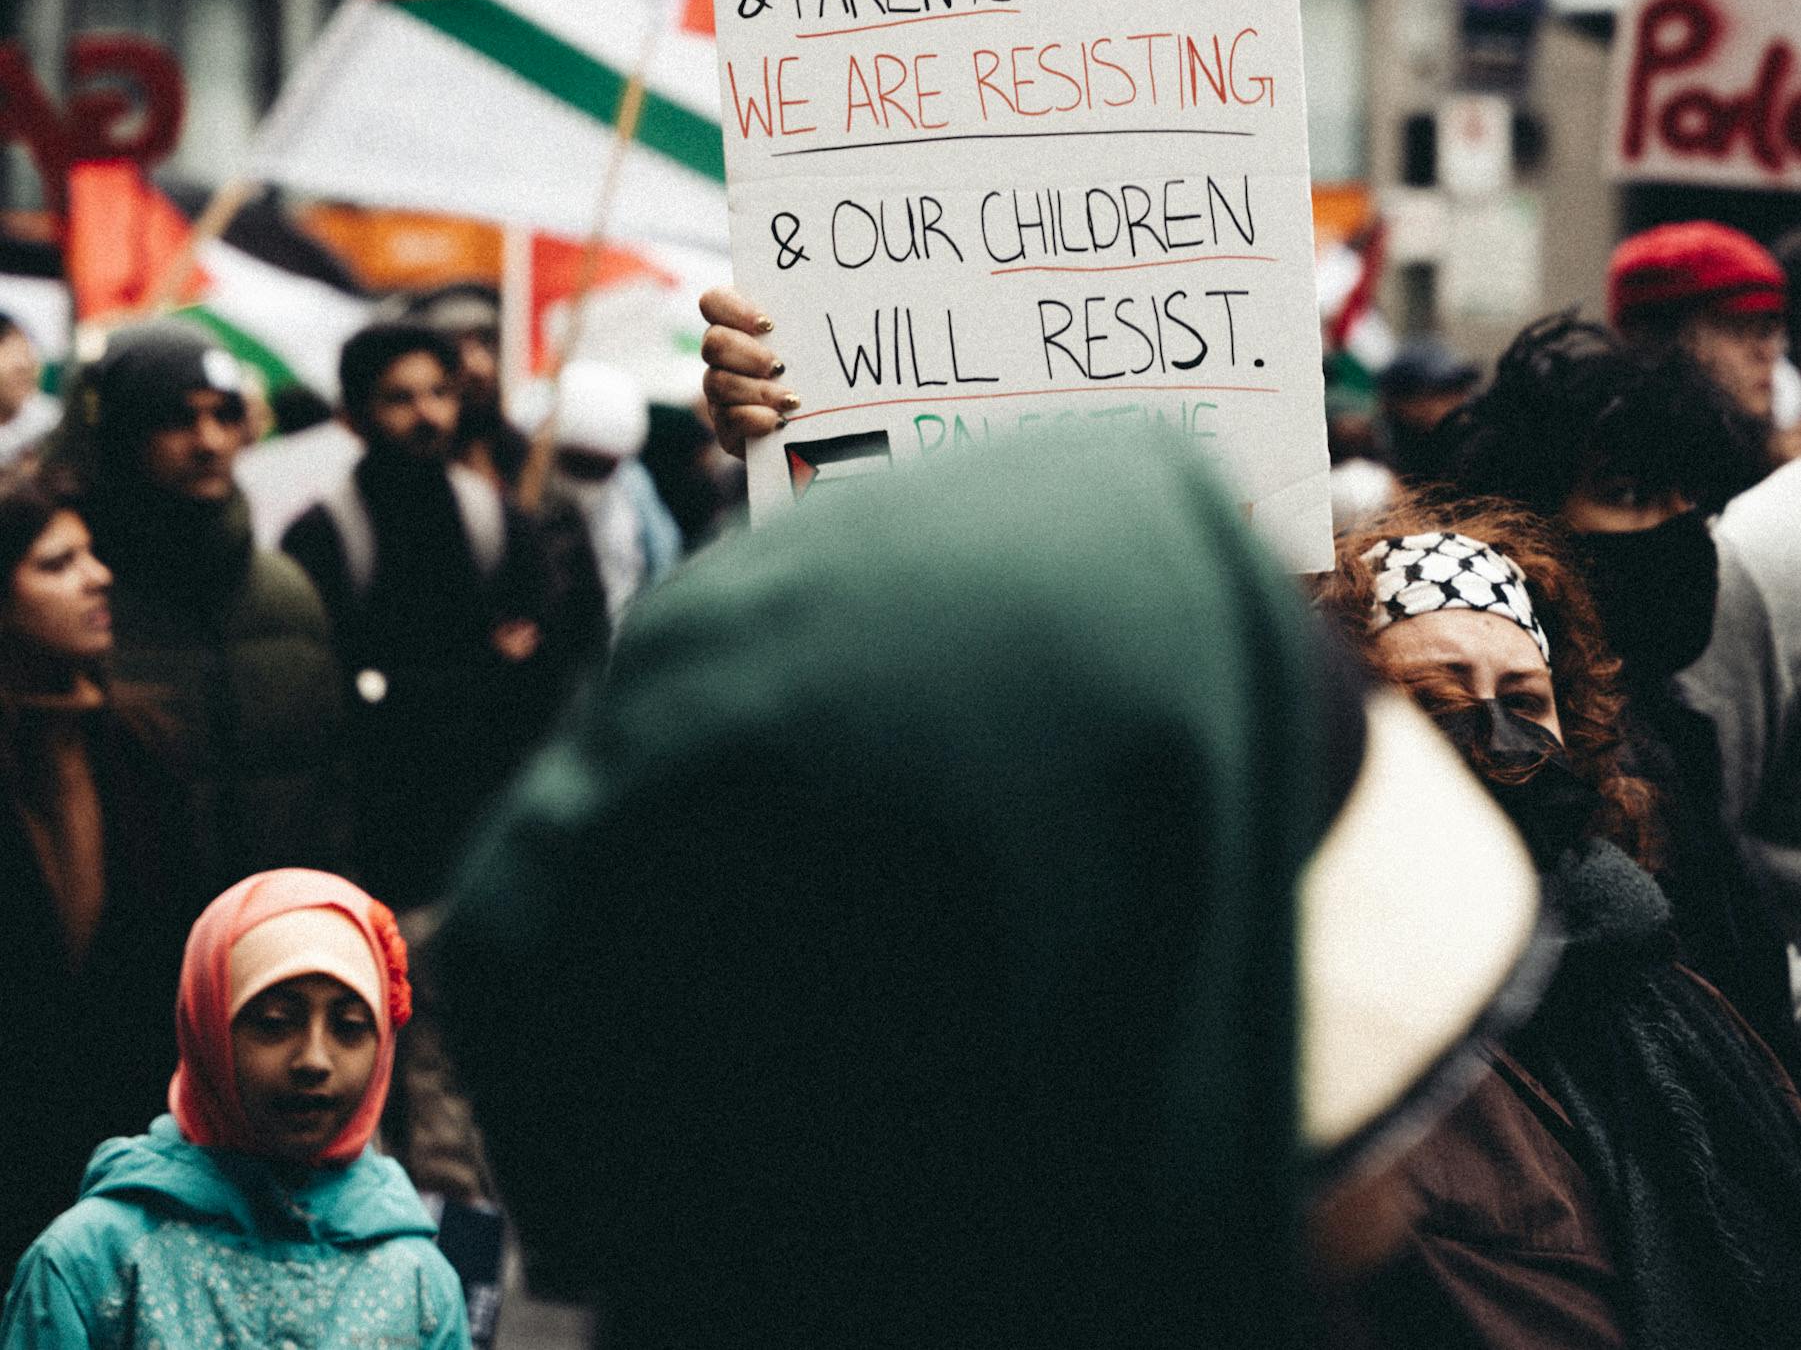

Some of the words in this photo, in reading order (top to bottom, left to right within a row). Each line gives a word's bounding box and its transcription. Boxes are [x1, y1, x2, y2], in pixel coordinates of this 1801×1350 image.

[727, 55, 818, 140] WE
[846, 52, 944, 134] ARE
[972, 27, 1277, 121] RESISTING
[770, 211, 811, 271] &
[831, 195, 965, 270] OUR
[980, 174, 1256, 264] CHILDREN
[825, 306, 1000, 389] WILL
[1036, 289, 1267, 382] RESIST.
